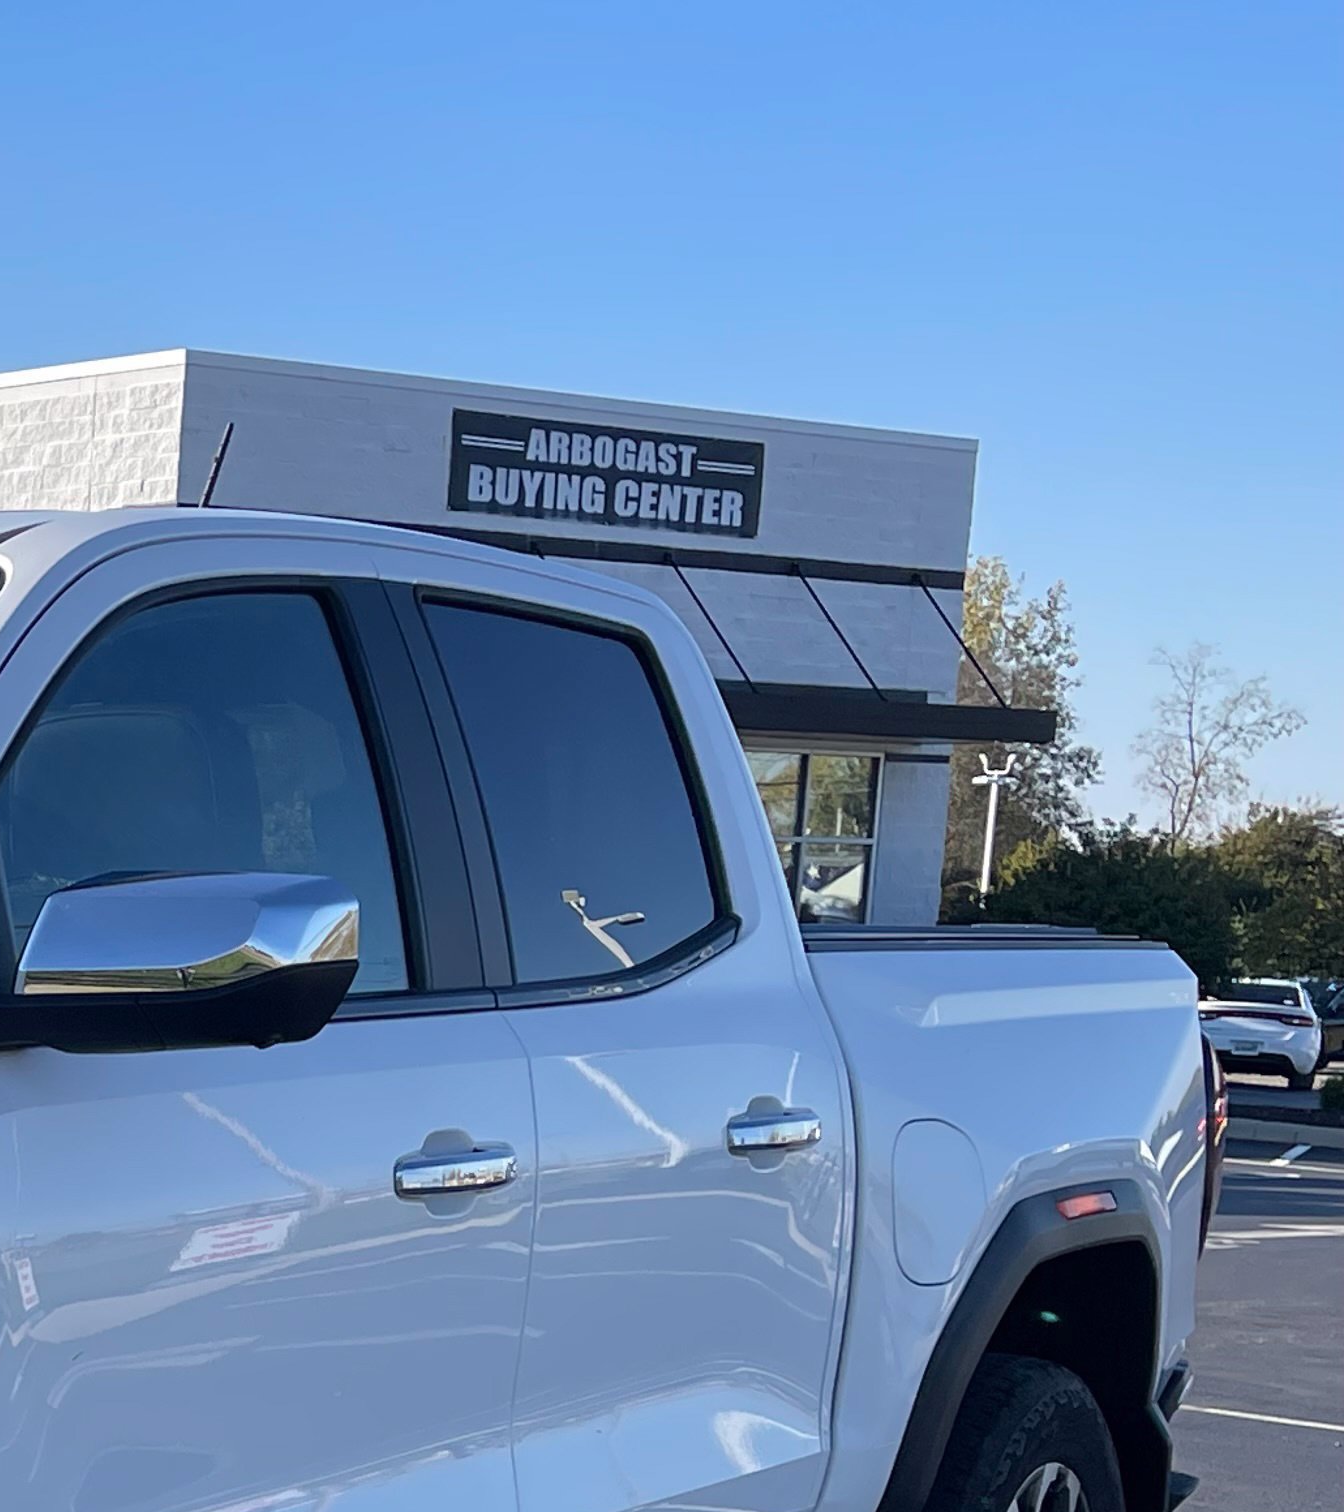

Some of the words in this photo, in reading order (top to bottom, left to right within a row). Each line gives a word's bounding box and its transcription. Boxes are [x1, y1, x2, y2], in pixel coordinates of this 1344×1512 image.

[525, 427, 698, 478] ARBOGAST
[467, 463, 607, 515] BUYING
[614, 479, 744, 528] CENTER
